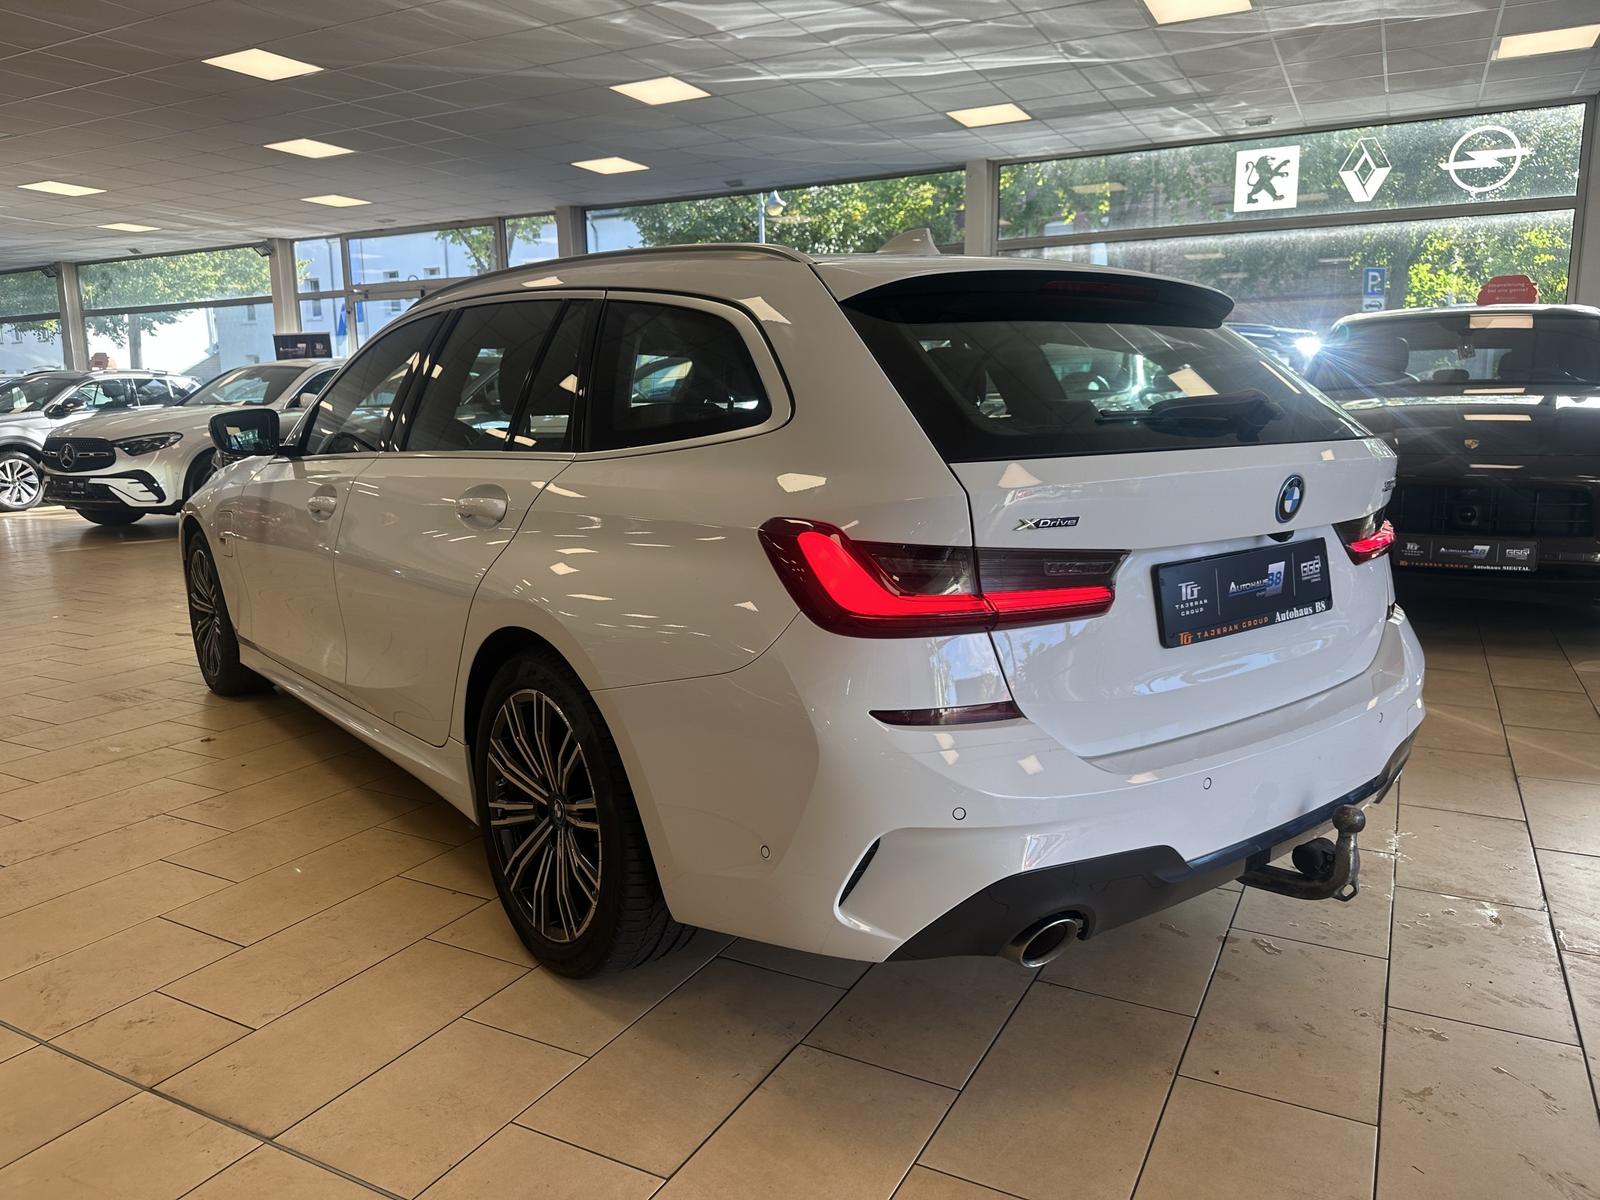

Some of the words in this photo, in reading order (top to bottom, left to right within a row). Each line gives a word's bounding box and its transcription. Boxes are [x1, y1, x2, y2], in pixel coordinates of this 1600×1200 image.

[1368, 271, 1380, 293] P
[1181, 607, 1204, 616] GROUP
[1275, 606, 1313, 623] Autohaus
[1241, 617, 1269, 629] GROUP
